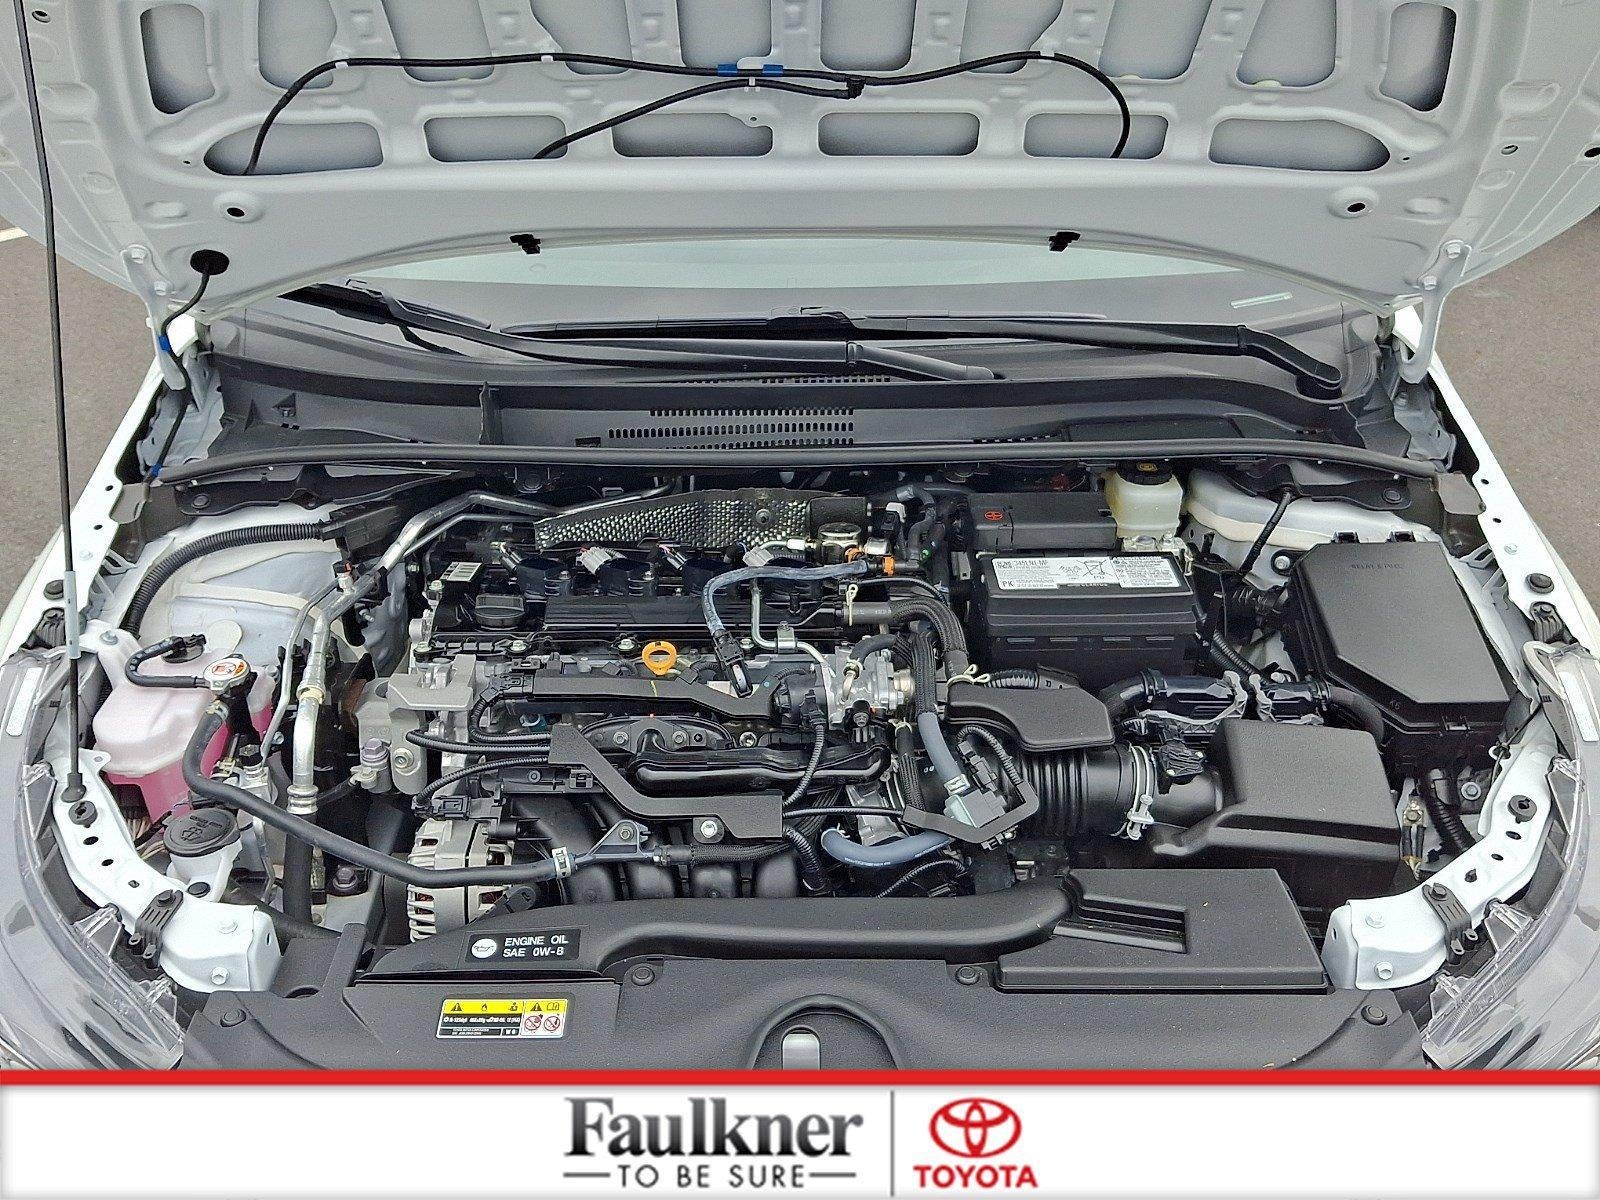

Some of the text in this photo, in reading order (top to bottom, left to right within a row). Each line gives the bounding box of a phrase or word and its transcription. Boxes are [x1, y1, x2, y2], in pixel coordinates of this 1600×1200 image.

[504, 934, 569, 947] ENGINE OIL
[503, 947, 527, 958] SAE
